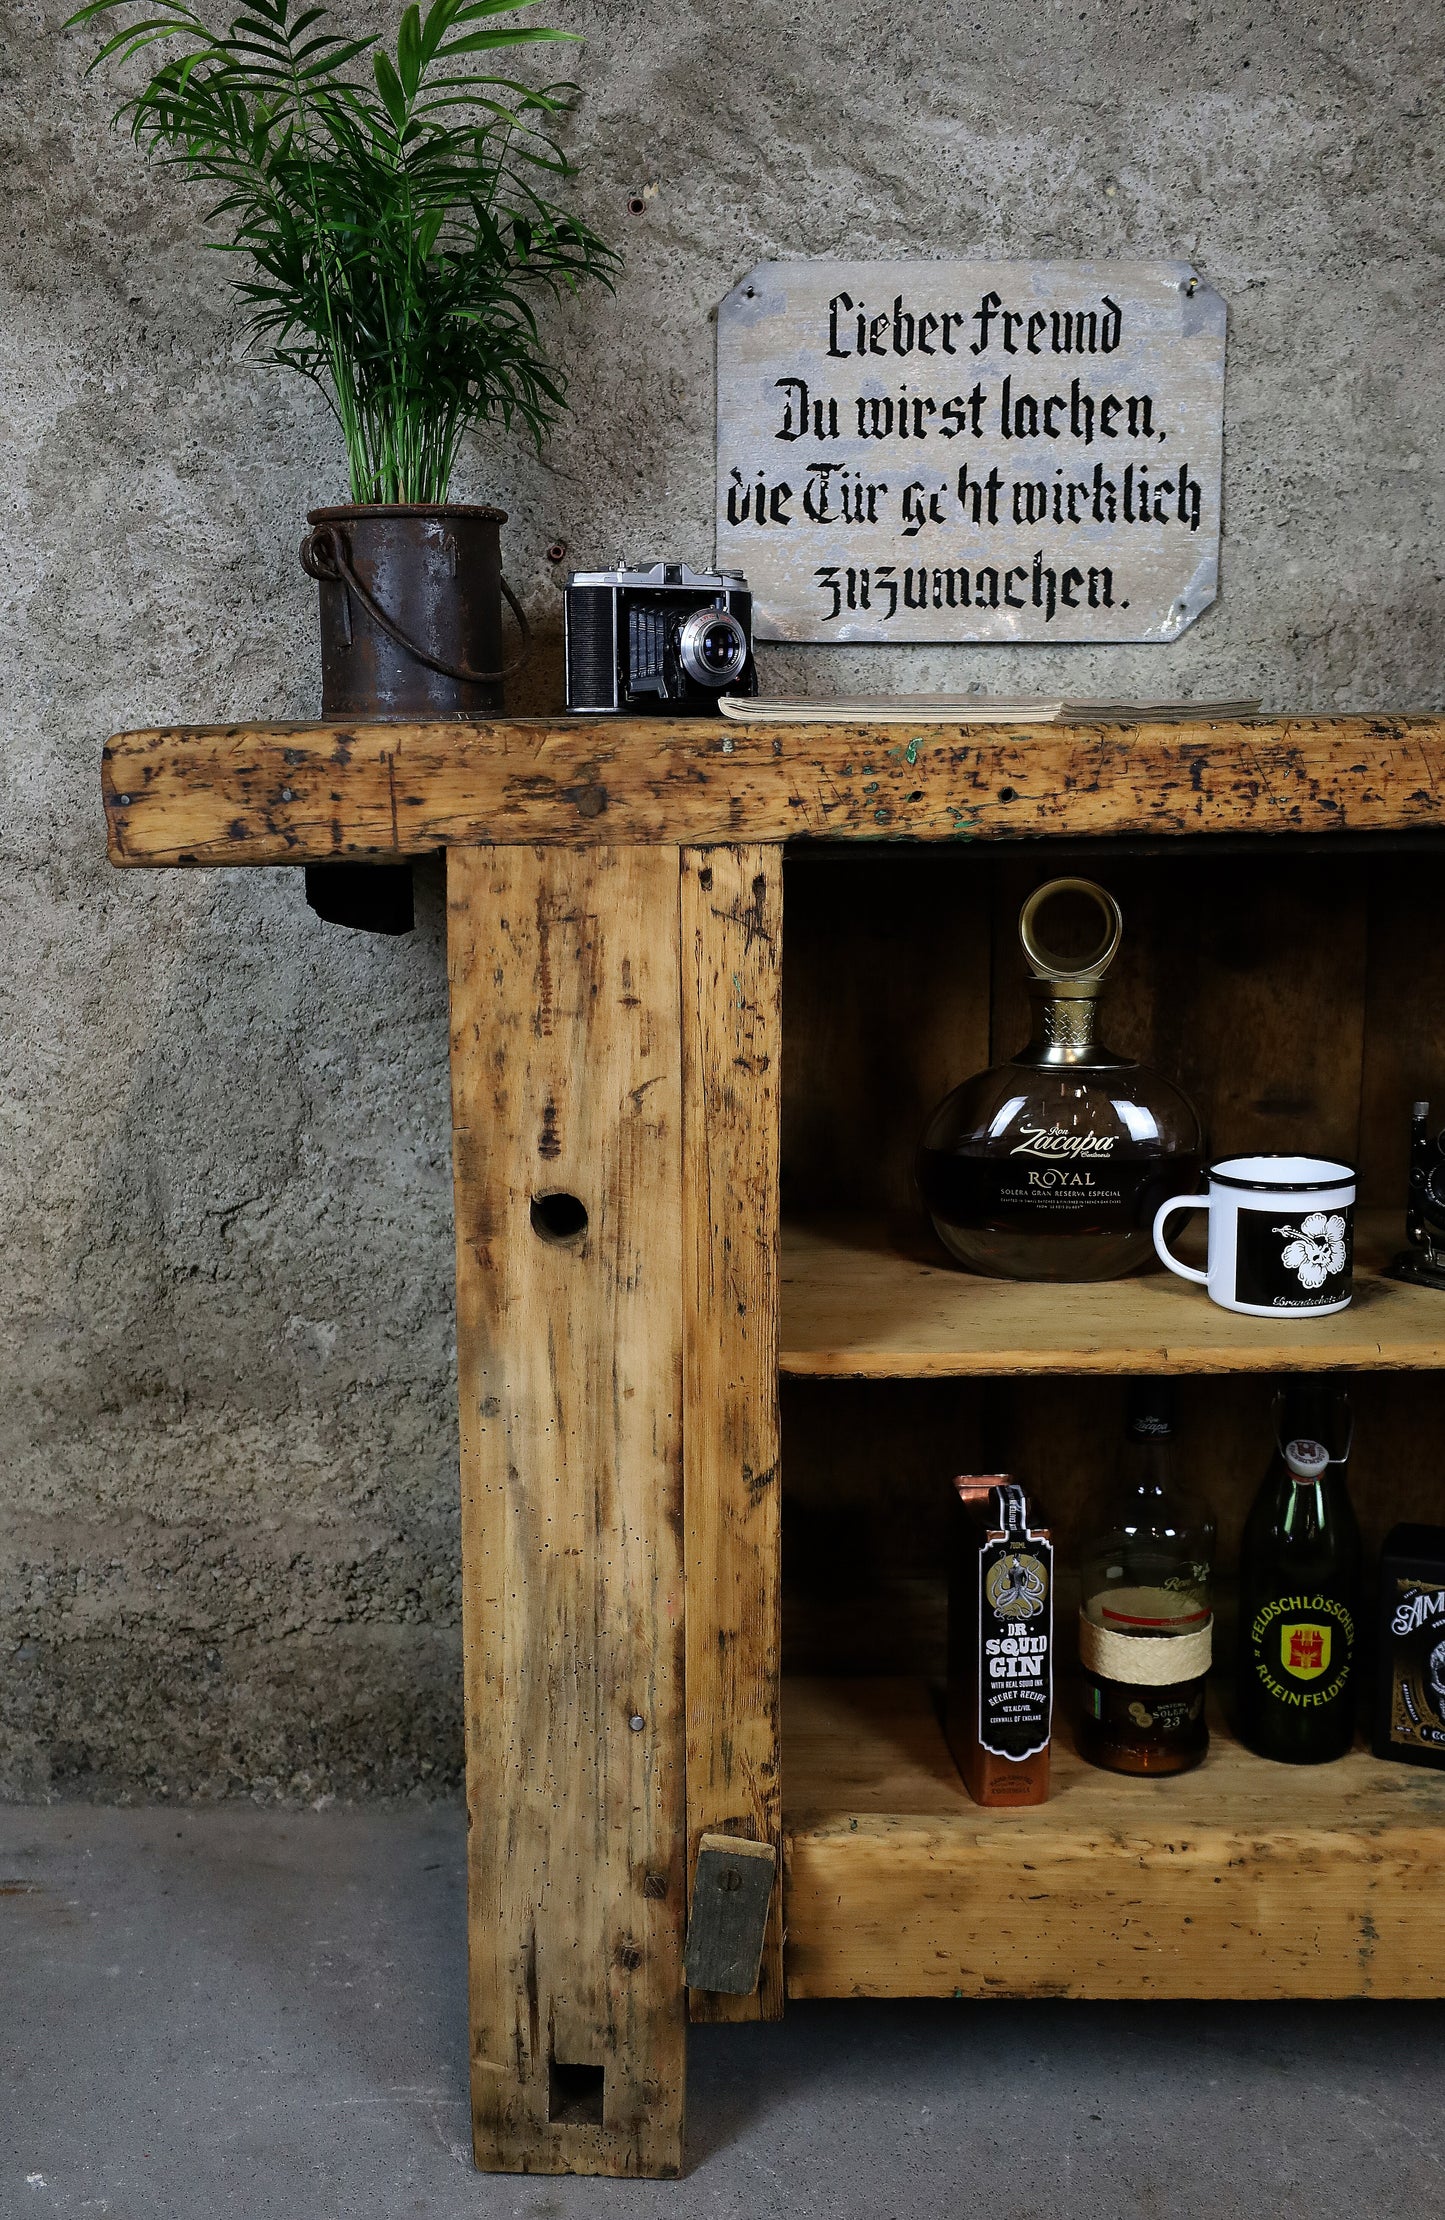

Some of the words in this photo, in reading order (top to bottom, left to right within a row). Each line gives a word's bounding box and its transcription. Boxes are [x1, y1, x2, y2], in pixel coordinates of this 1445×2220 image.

[826, 291, 964, 359] Lieber
[774, 377, 840, 441] Du
[856, 382, 987, 439] wirst
[1001, 374, 1167, 445] lachen,
[727, 466, 793, 526] die
[803, 463, 888, 524] Tür
[1012, 462, 1202, 534] wirklich
[814, 549, 1131, 623] zuzumachen.
[1048, 1126, 1069, 1136] Ron
[1010, 1126, 1114, 1159] Zacapa
[1028, 1168, 1096, 1188] ROYAL
[1000, 1188, 1029, 1196] SOLERA
[1031, 1189, 1052, 1197] GRAN
[1007, 1623, 1027, 1636] DR
[1251, 1594, 1354, 1646] FELDSCHLÖSSCHEN
[985, 1635, 1048, 1656] SQUID
[989, 1655, 1044, 1678] GIN
[990, 1681, 1005, 1689] WITH
[1005, 1680, 1018, 1688] REAL
[1256, 1664, 1350, 1707] RHEINFELDEN
[988, 1690, 1018, 1706] SECRET
[1020, 1690, 1047, 1703] RECIPE
[1163, 1717, 1180, 1728] 23
